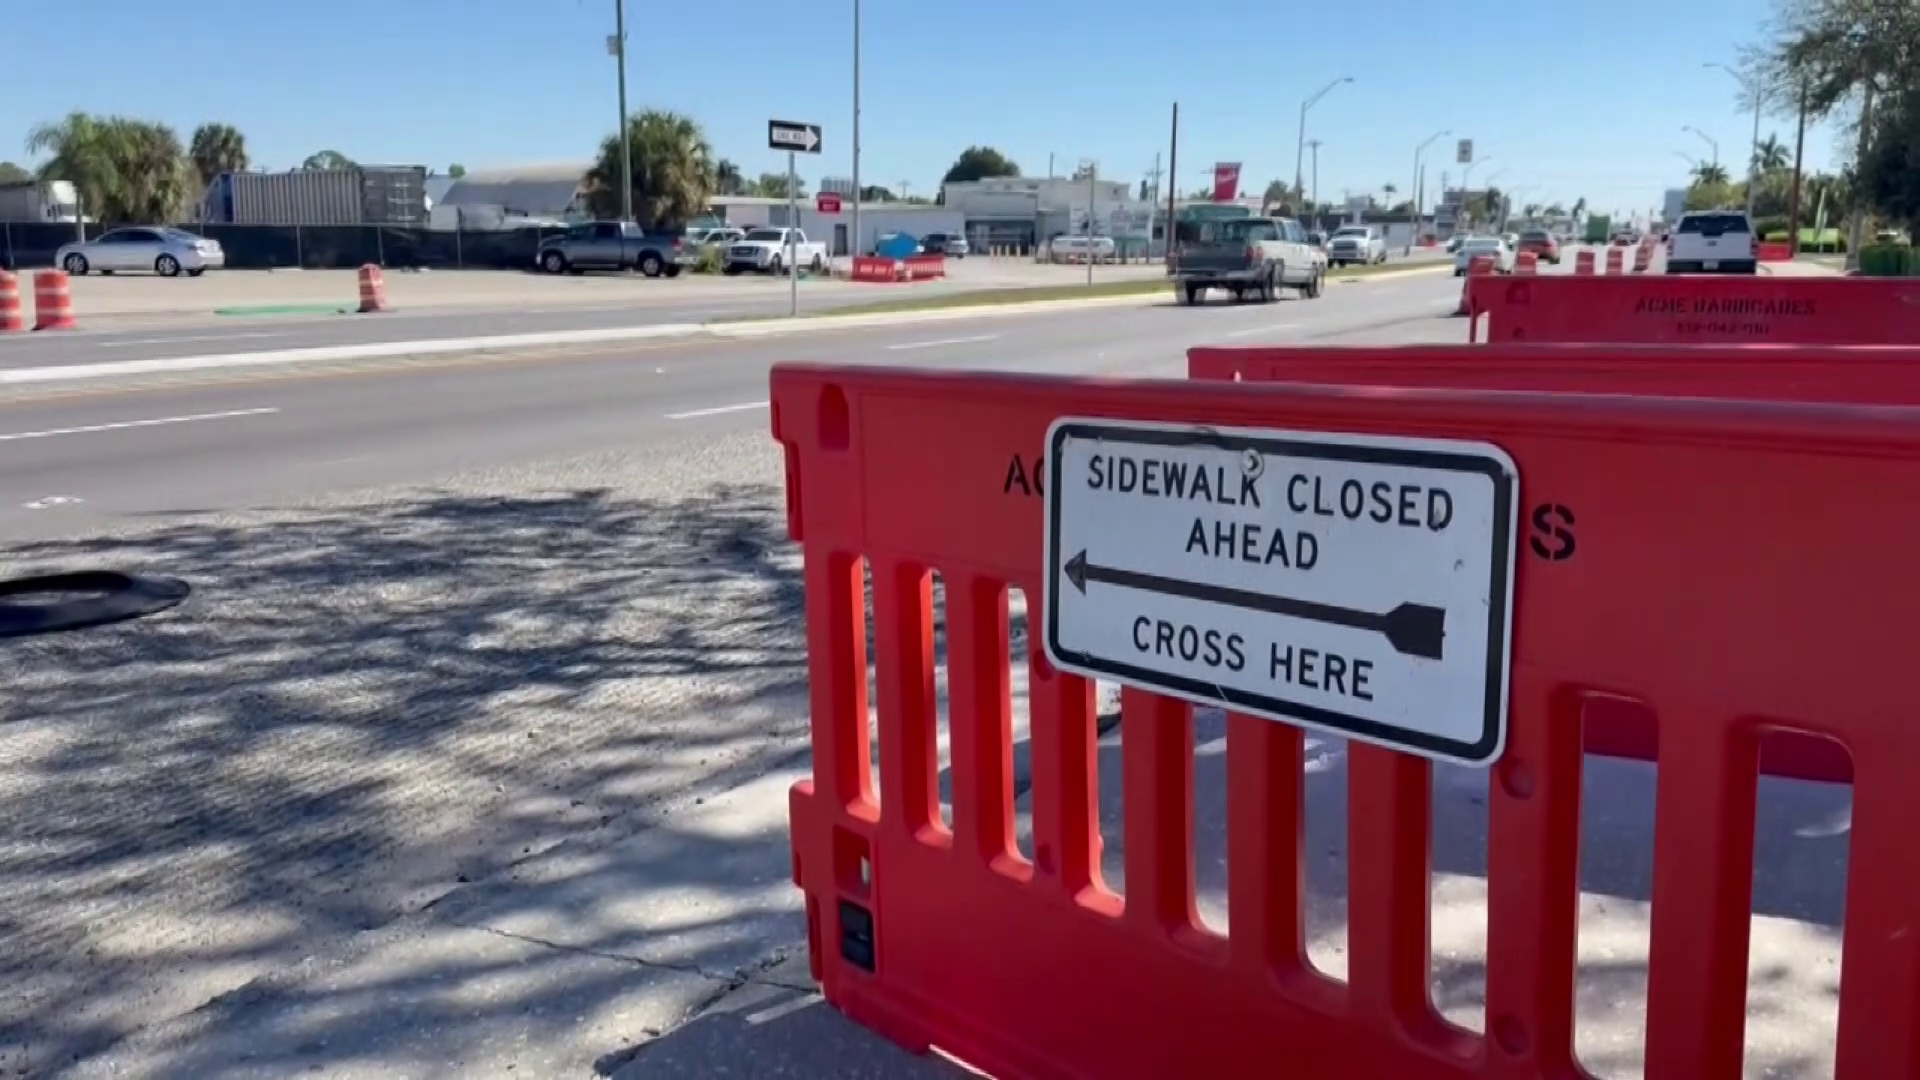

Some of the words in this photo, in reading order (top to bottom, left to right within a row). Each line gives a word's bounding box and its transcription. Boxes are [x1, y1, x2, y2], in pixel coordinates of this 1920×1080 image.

[1634, 296, 1687, 314] ACME
[1087, 455, 1261, 508] SIDEWALK
[1287, 474, 1454, 532] CLOSED
[1186, 517, 1319, 571] AHEAD
[1133, 614, 1246, 672] CROSS
[1269, 642, 1374, 701] HERE
